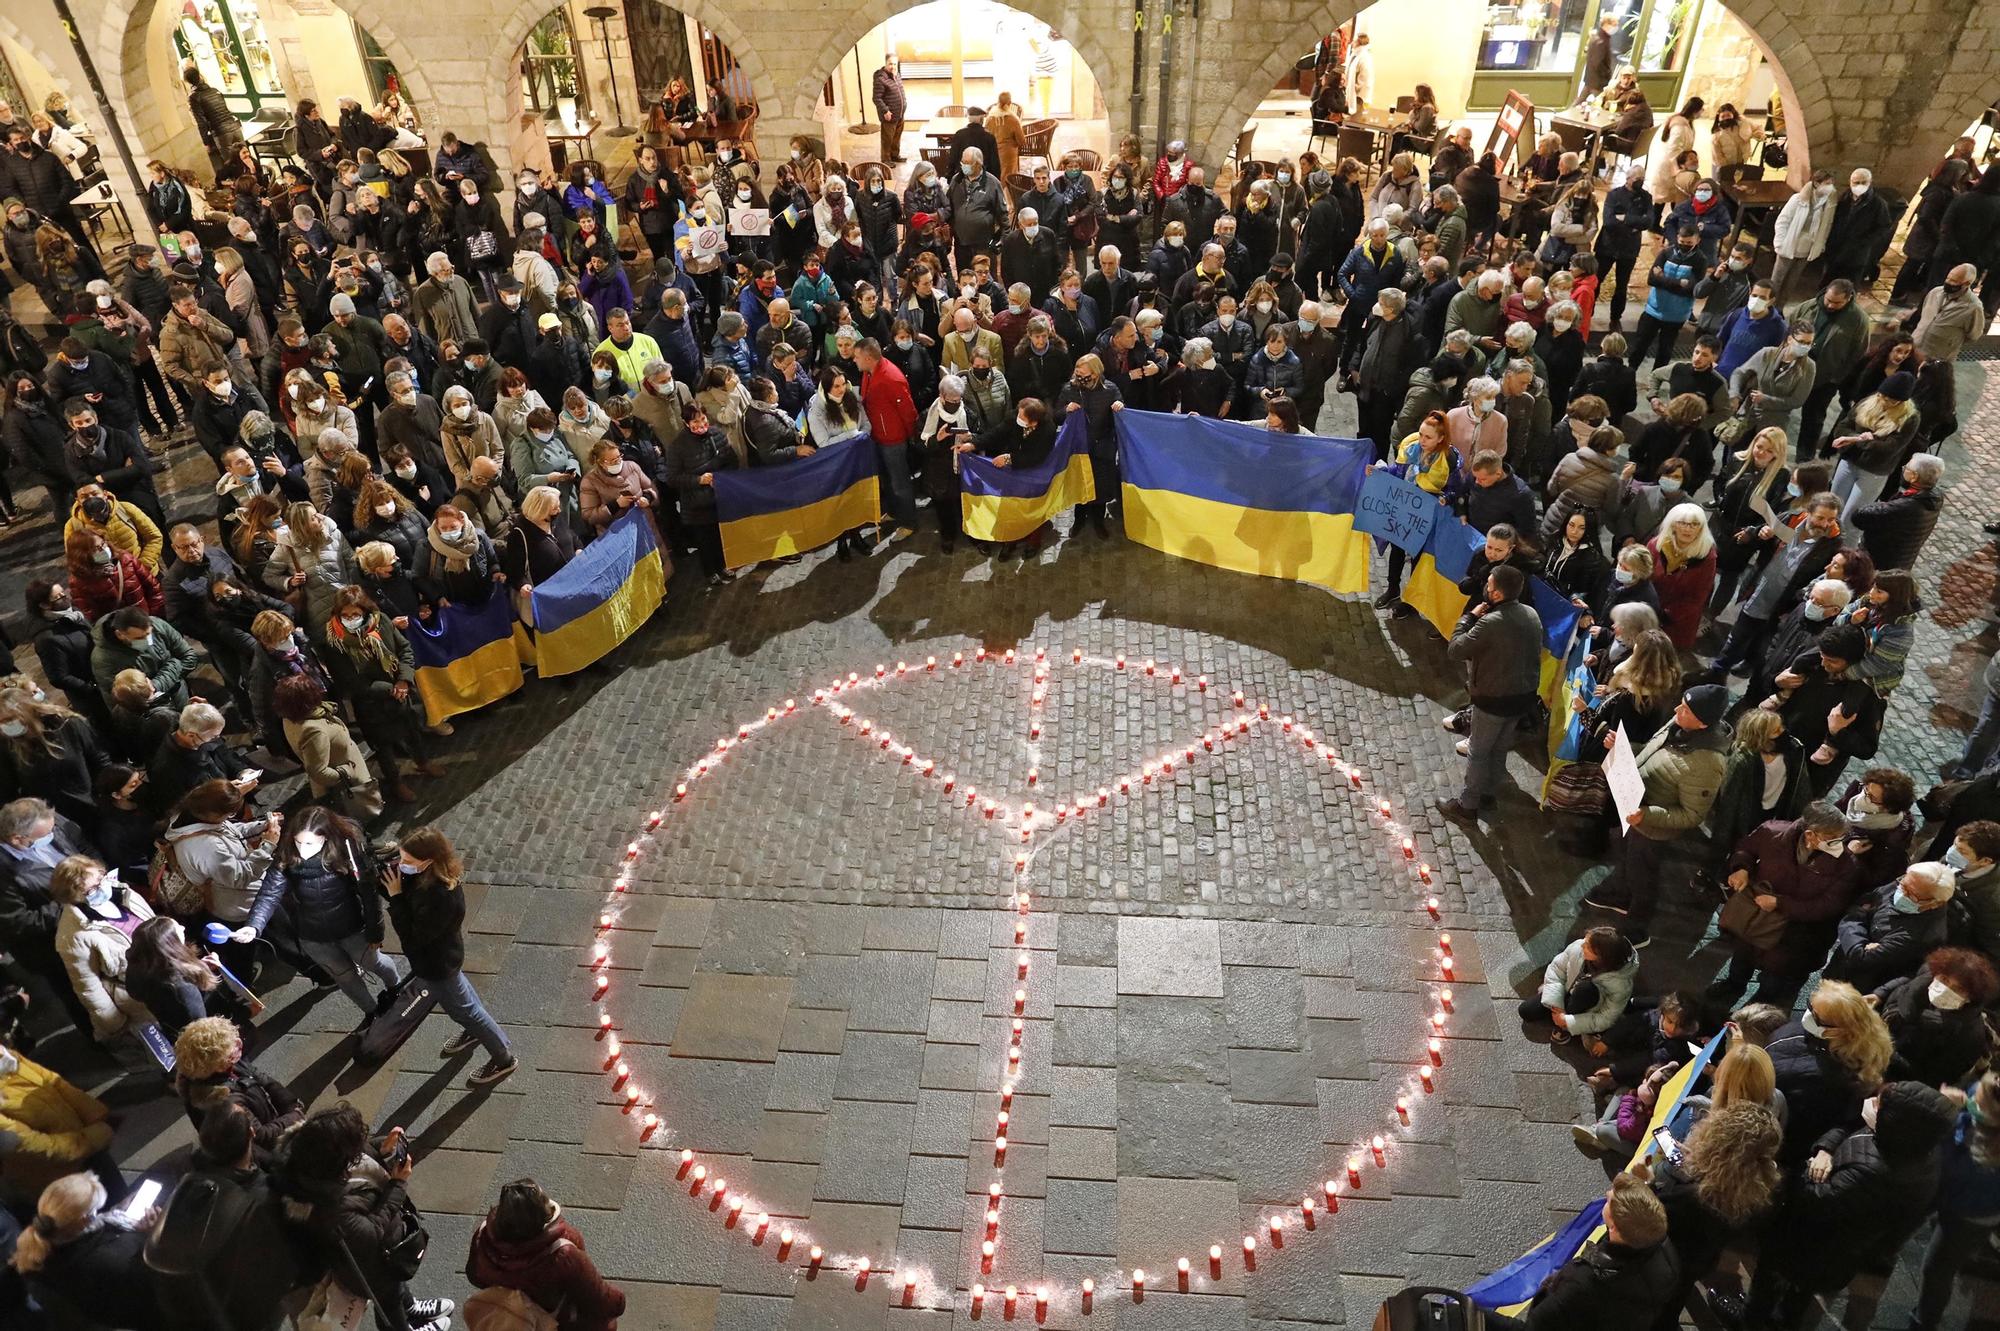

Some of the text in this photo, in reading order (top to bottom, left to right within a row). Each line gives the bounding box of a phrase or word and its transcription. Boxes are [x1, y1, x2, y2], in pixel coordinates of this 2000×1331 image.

[1386, 485, 1423, 509] NATO
[1362, 495, 1429, 535] CLOSE THE
[1383, 518, 1412, 541] SKY
